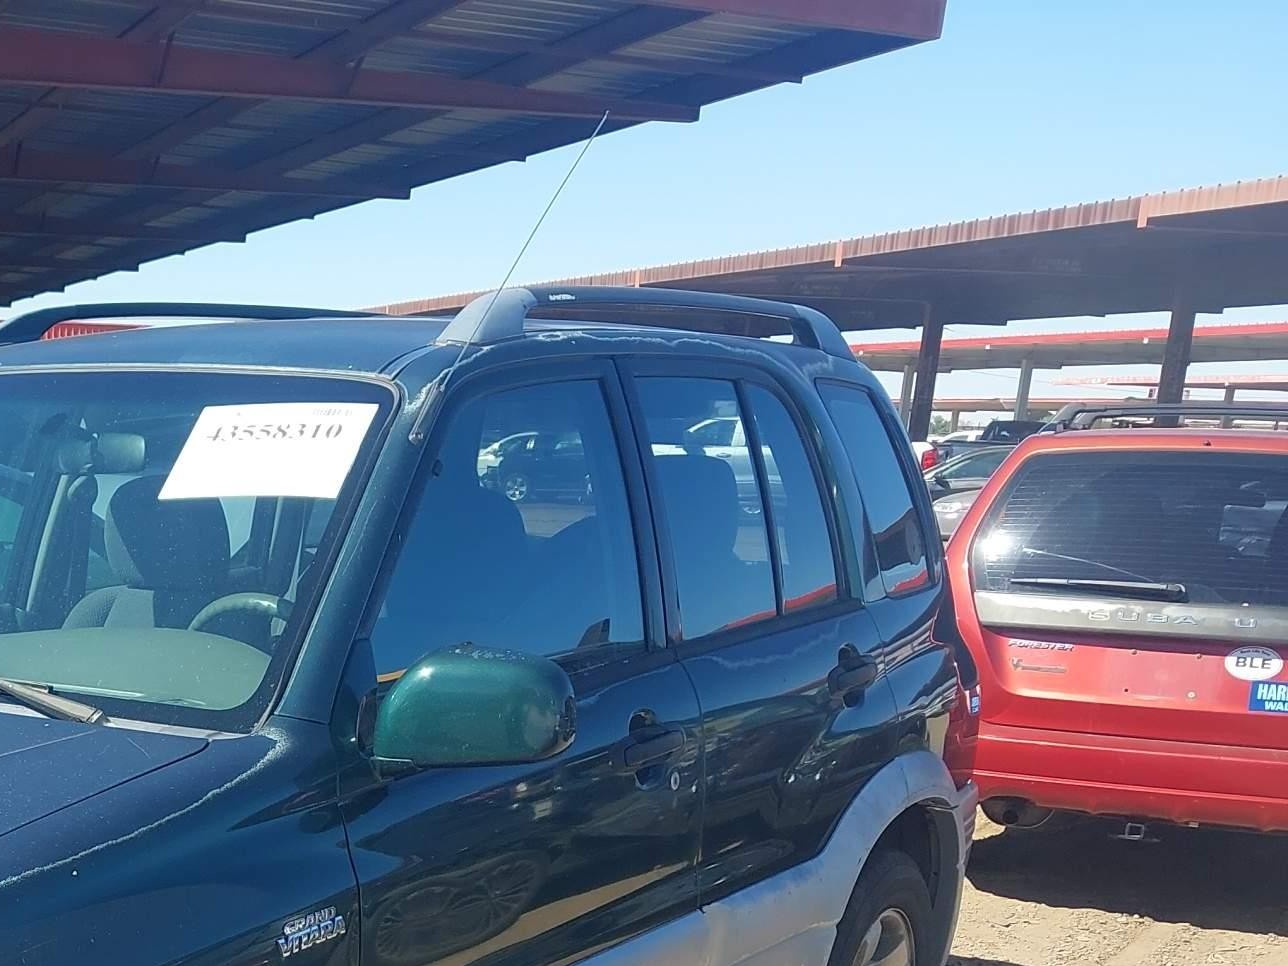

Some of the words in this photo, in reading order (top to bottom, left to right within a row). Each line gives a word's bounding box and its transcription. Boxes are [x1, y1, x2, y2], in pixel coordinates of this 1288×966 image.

[206, 423, 344, 442] 43558310
[1235, 656, 1271, 670] BLE
[1256, 683, 1288, 702] HAR
[1264, 701, 1288, 712] WA
[283, 906, 337, 935] GRAND
[276, 915, 347, 958] VITARA
